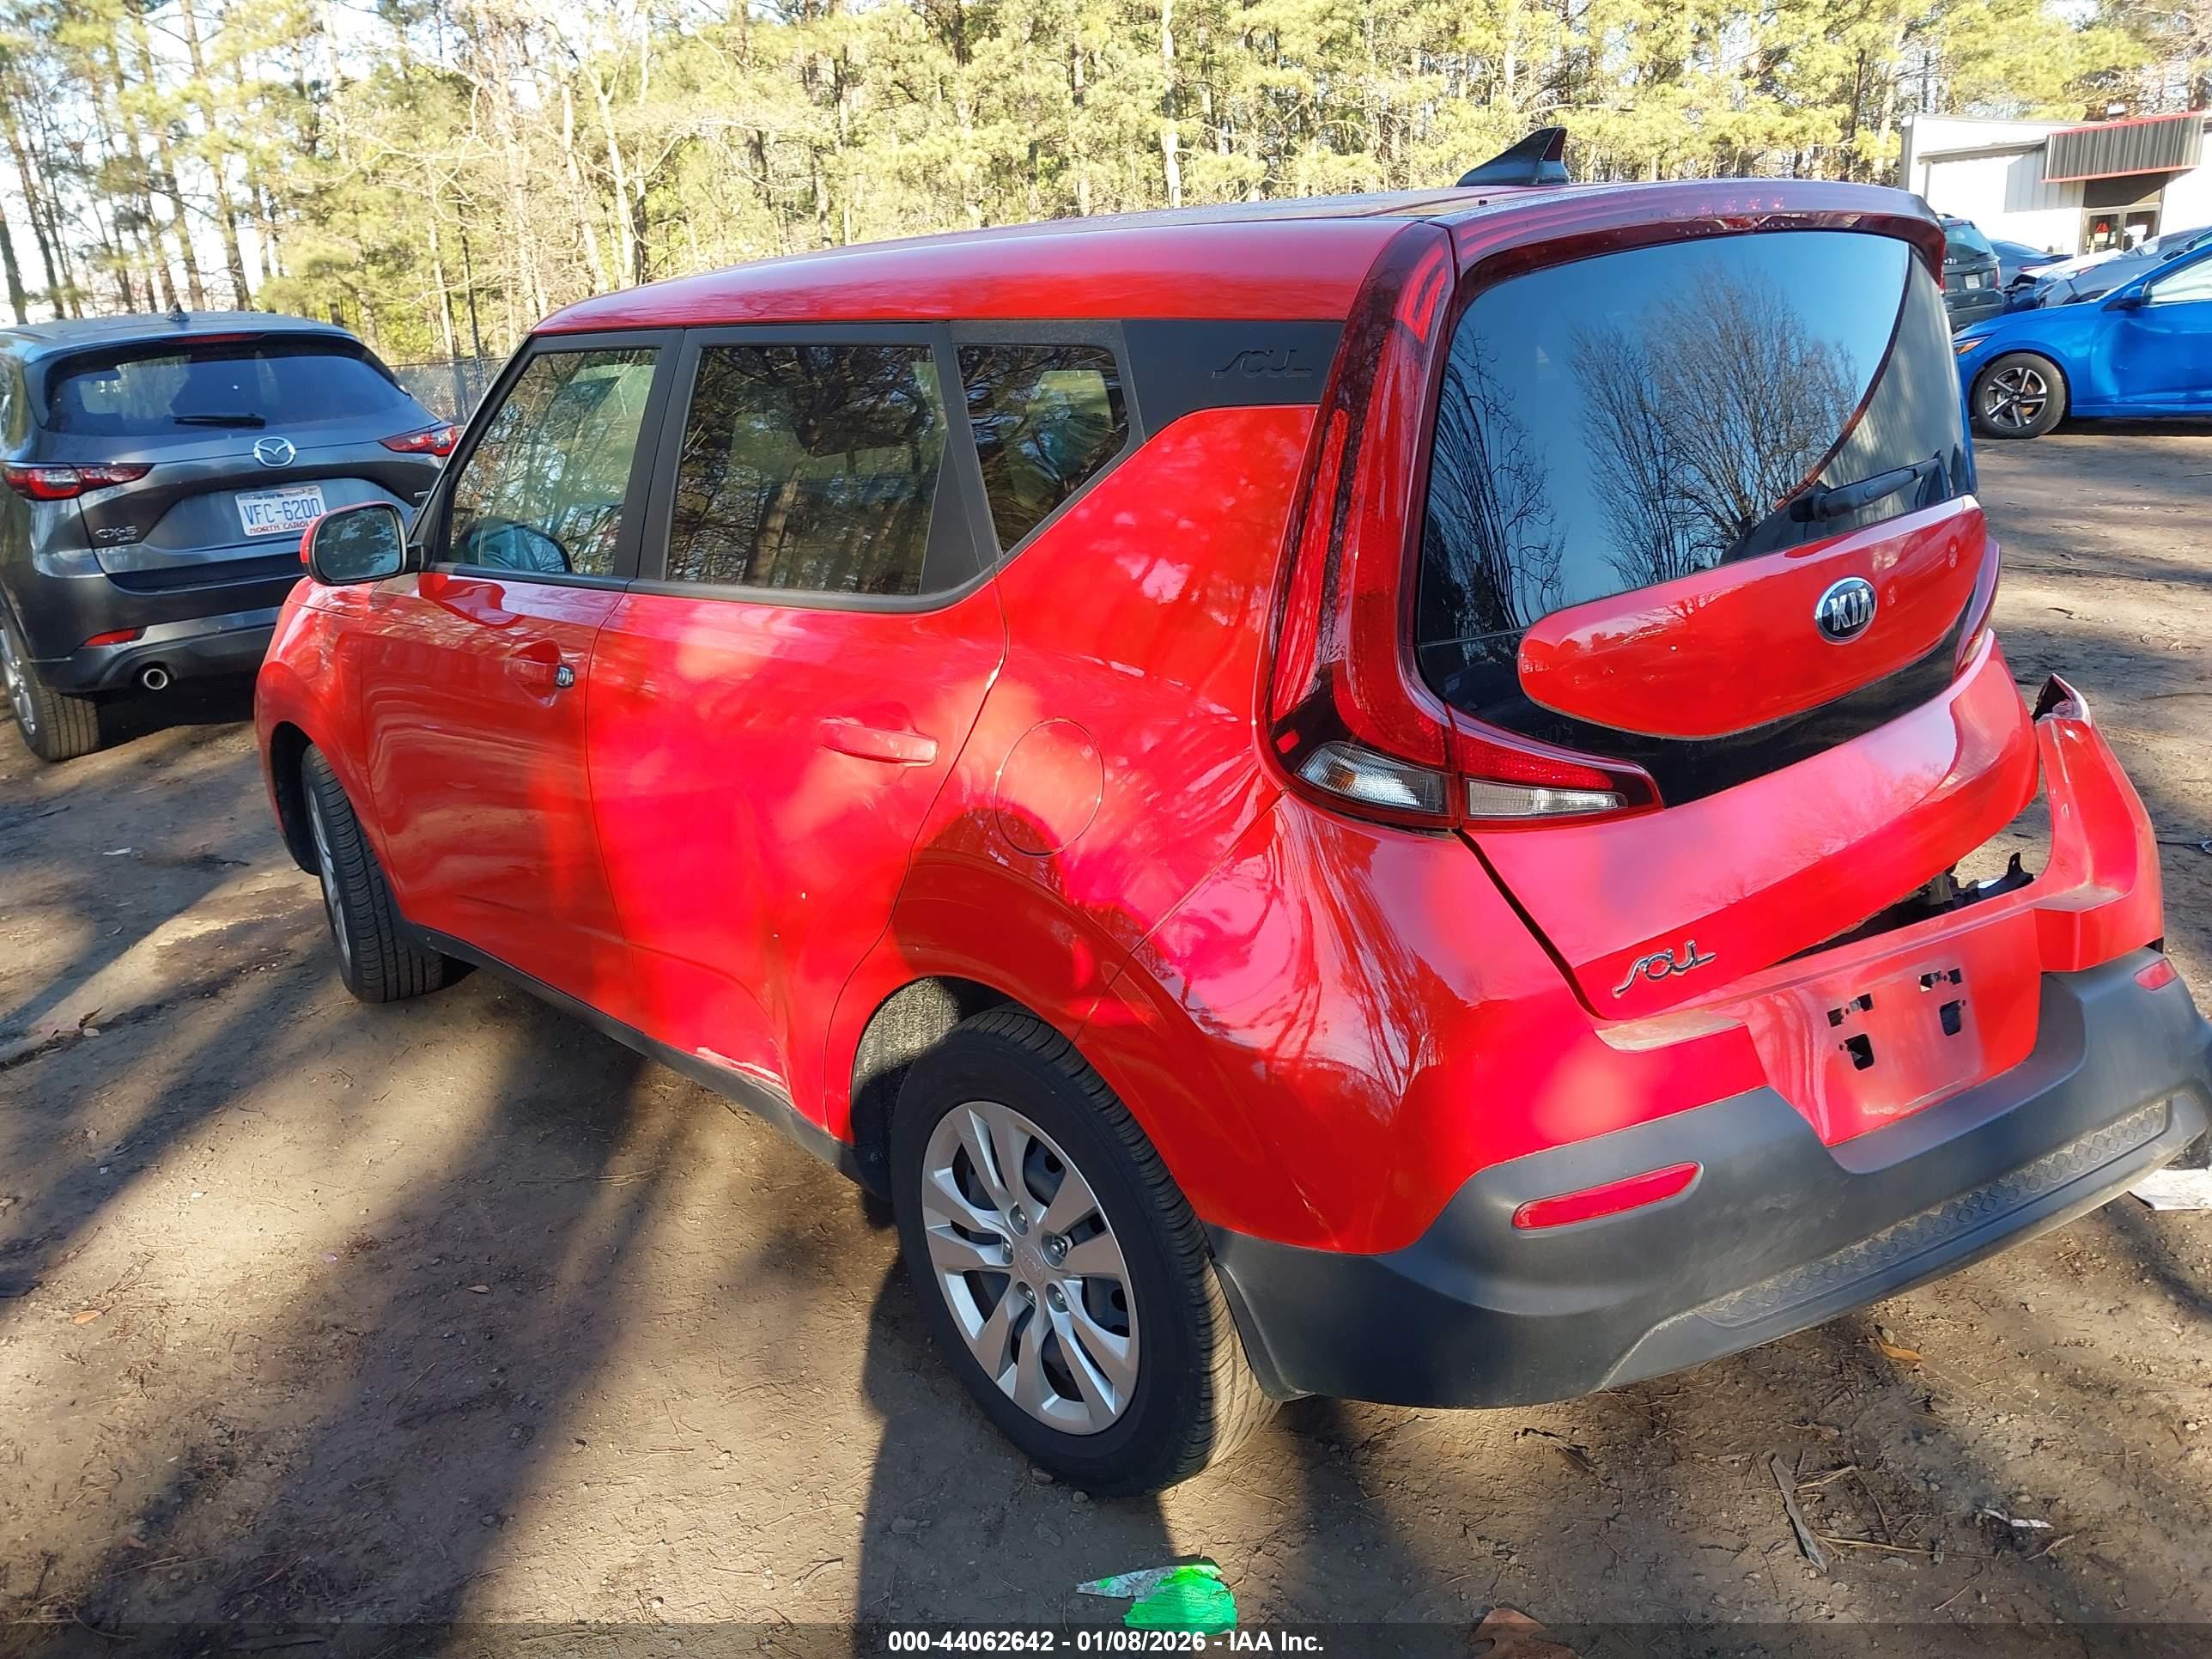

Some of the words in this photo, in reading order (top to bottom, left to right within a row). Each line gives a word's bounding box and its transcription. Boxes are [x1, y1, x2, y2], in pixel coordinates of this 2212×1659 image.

[243, 497, 322, 526] VFC-6200
[95, 525, 137, 538] CX-5
[249, 523, 281, 533] NORTH
[1828, 587, 1873, 631] KIA
[1612, 939, 1717, 999] SOUL
